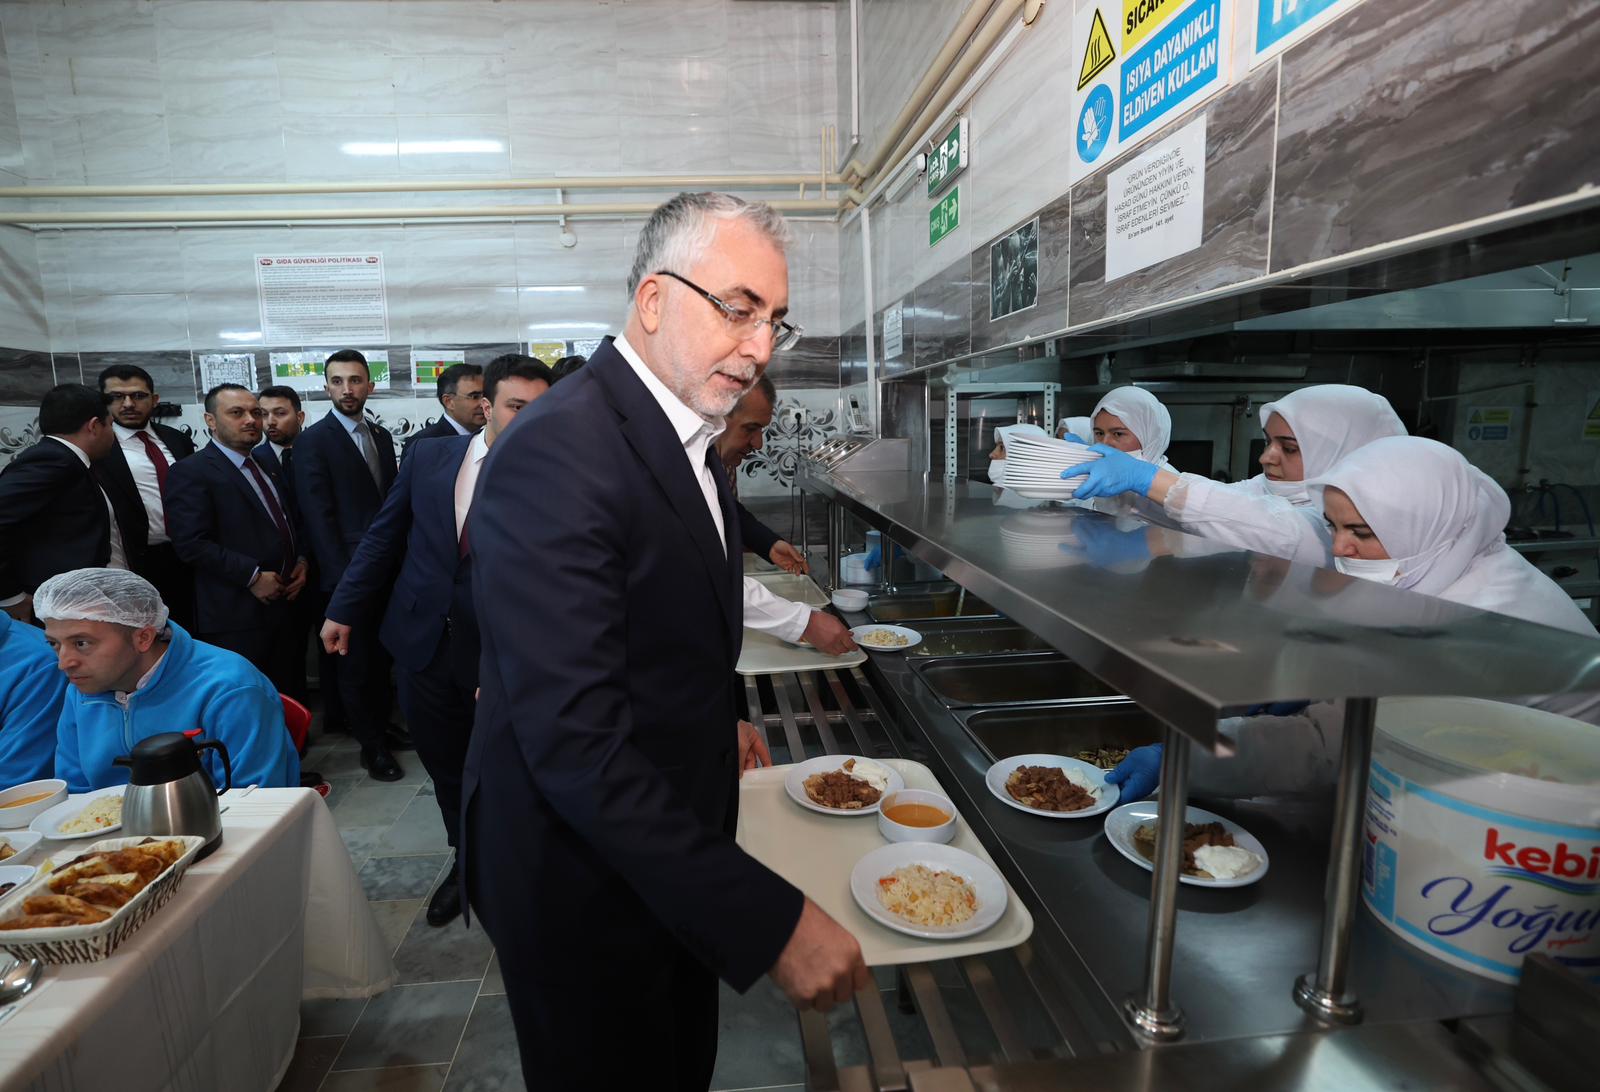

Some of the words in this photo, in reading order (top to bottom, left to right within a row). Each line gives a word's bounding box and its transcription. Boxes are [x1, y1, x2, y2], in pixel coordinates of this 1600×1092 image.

[1126, 57, 1152, 96] ISIYA
[1153, 3, 1216, 74] DAYANIKLI
[1168, 38, 1216, 96] KULLAN
[276, 257, 292, 265] GIDA
[293, 256, 327, 265] GÜVENLİĞİ
[1484, 827, 1600, 880] kebi
